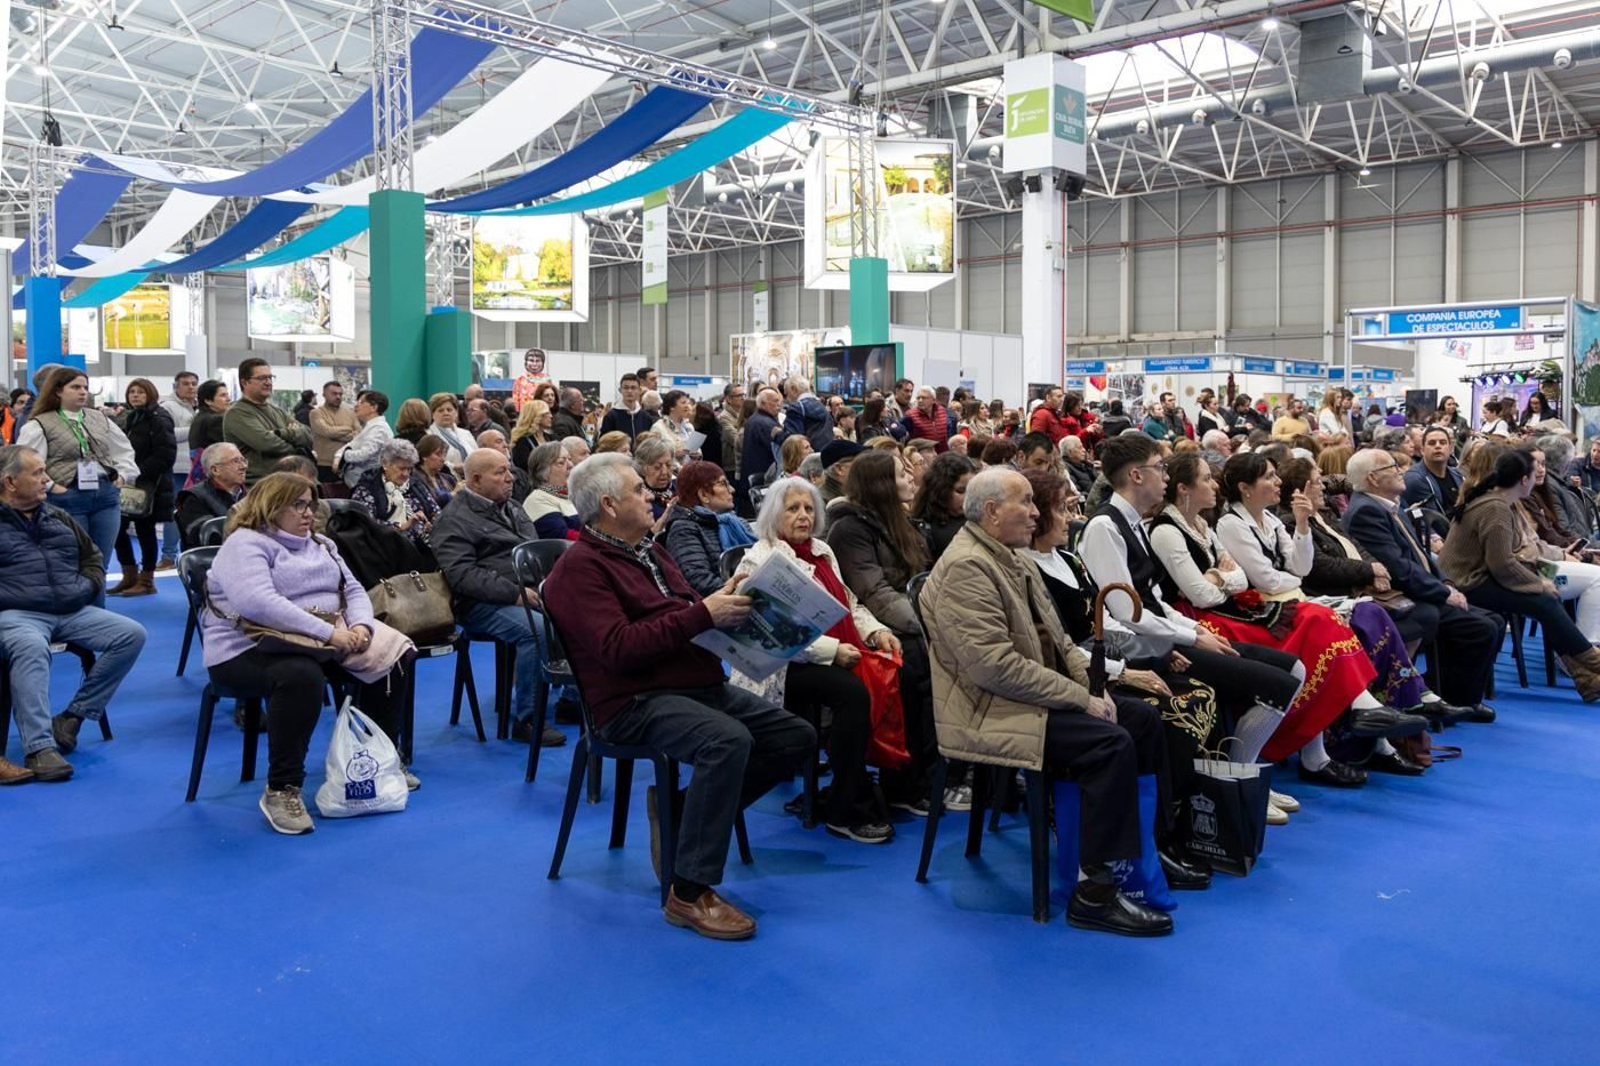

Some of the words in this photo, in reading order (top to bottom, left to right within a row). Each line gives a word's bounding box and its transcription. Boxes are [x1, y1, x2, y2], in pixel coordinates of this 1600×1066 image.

[1458, 309, 1501, 320] EUROPEA
[1412, 323, 1425, 333] DE
[347, 780, 373, 790] CASA
